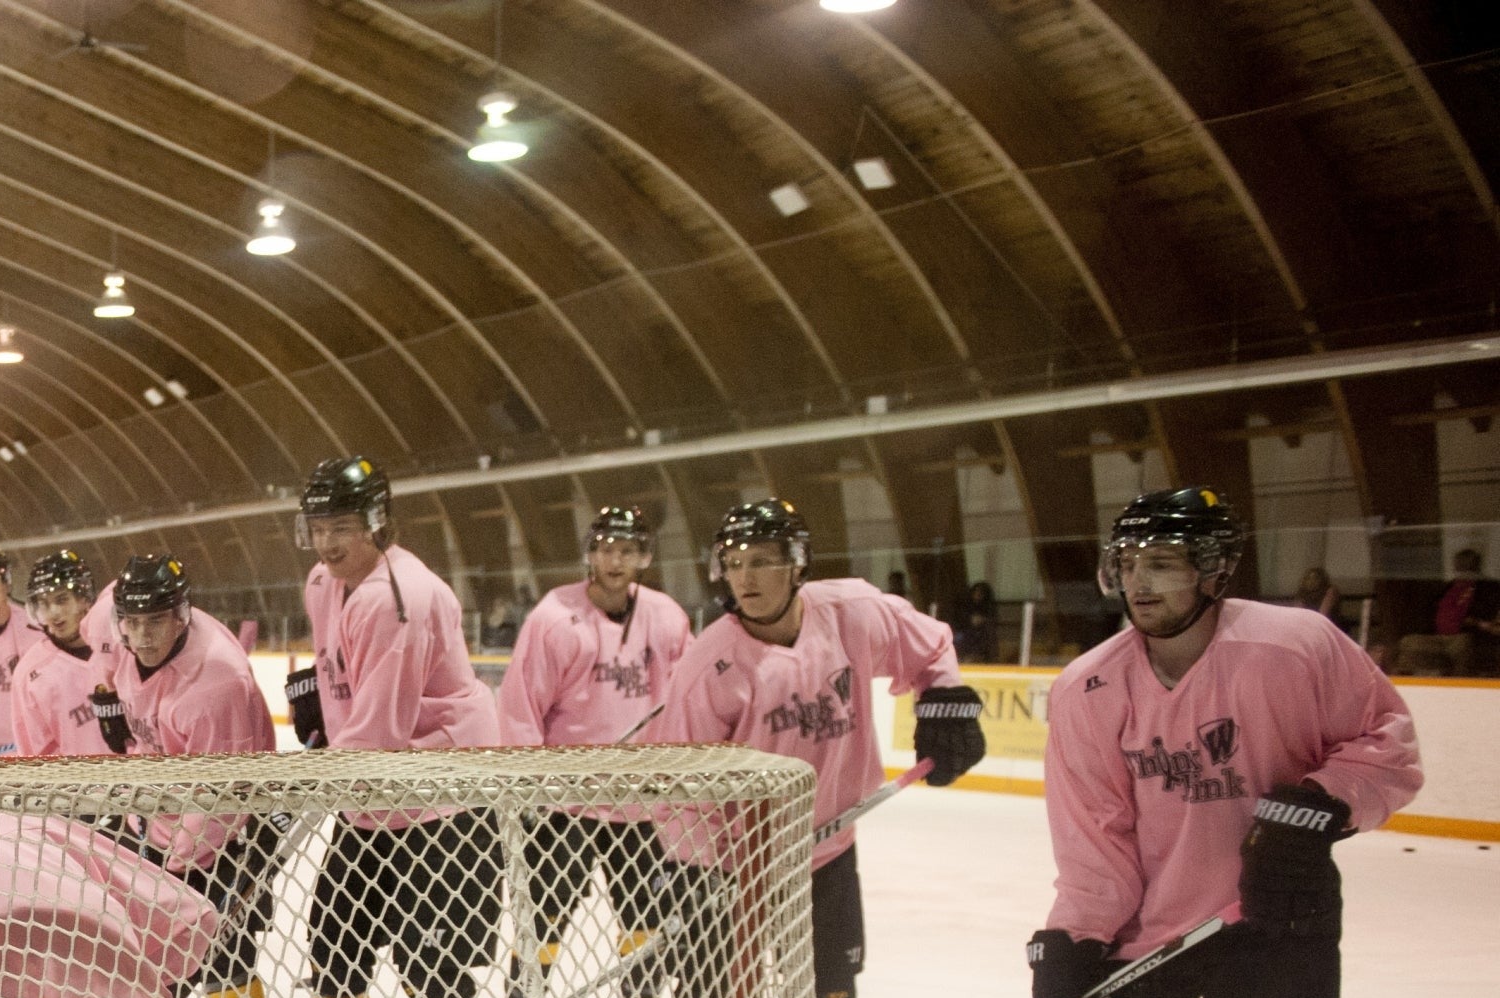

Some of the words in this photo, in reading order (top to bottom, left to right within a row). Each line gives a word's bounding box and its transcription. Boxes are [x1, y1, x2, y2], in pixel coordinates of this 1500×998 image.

[1120, 517, 1150, 526] CCM
[285, 676, 318, 700] RIOR
[764, 691, 836, 738] Think
